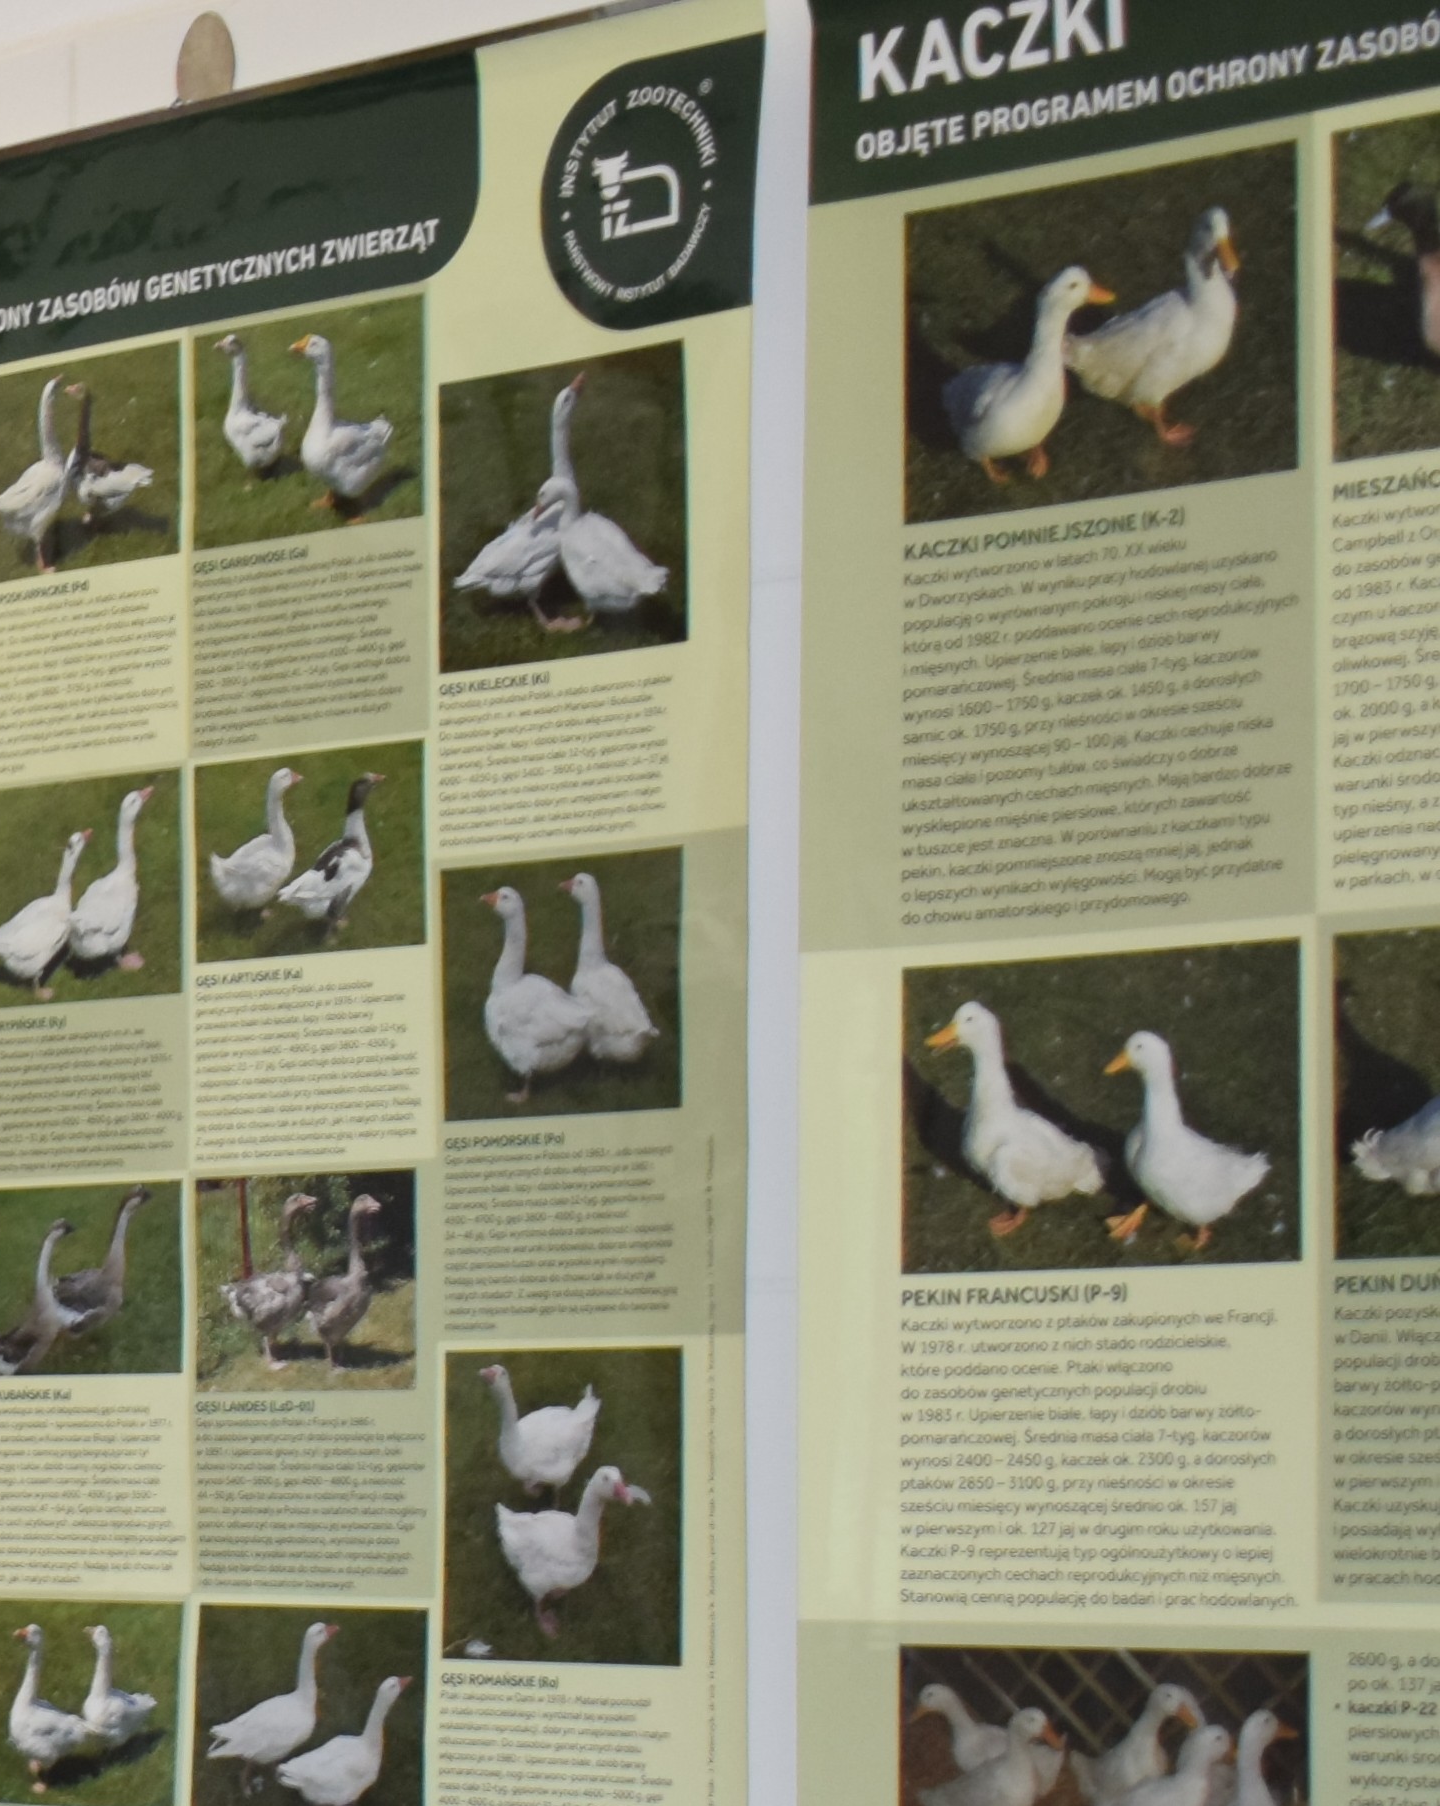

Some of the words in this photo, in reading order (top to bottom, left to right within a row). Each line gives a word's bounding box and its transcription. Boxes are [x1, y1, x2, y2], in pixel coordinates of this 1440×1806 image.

[857, 0, 1125, 101] KACZKI
[855, 114, 965, 162] OBJĘTE
[973, 75, 1157, 139] PROGRAMEM
[1165, 45, 1307, 100] OCHRONY
[559, 99, 617, 198] INSTYTUT
[625, 85, 717, 169] ZOOTECHNIKI
[37, 276, 141, 325] ZASOBÓW
[145, 245, 317, 304] GENETYCZNYCH
[321, 220, 439, 268] ZWIERZĄT
[903, 534, 979, 561] KACZKI
[983, 514, 1135, 551] POMNIEJSZONE
[901, 1287, 961, 1307] PEKIN
[965, 1284, 1079, 1305] FRANCUSKI
[1083, 1282, 1127, 1305] (P-9)
[1333, 1275, 1395, 1294] PEKIN
[899, 1315, 949, 1331] Kaczki
[951, 1314, 1043, 1334] wytworzono
[1057, 1312, 1109, 1332] ptaków
[1111, 1310, 1201, 1330] zakupionych
